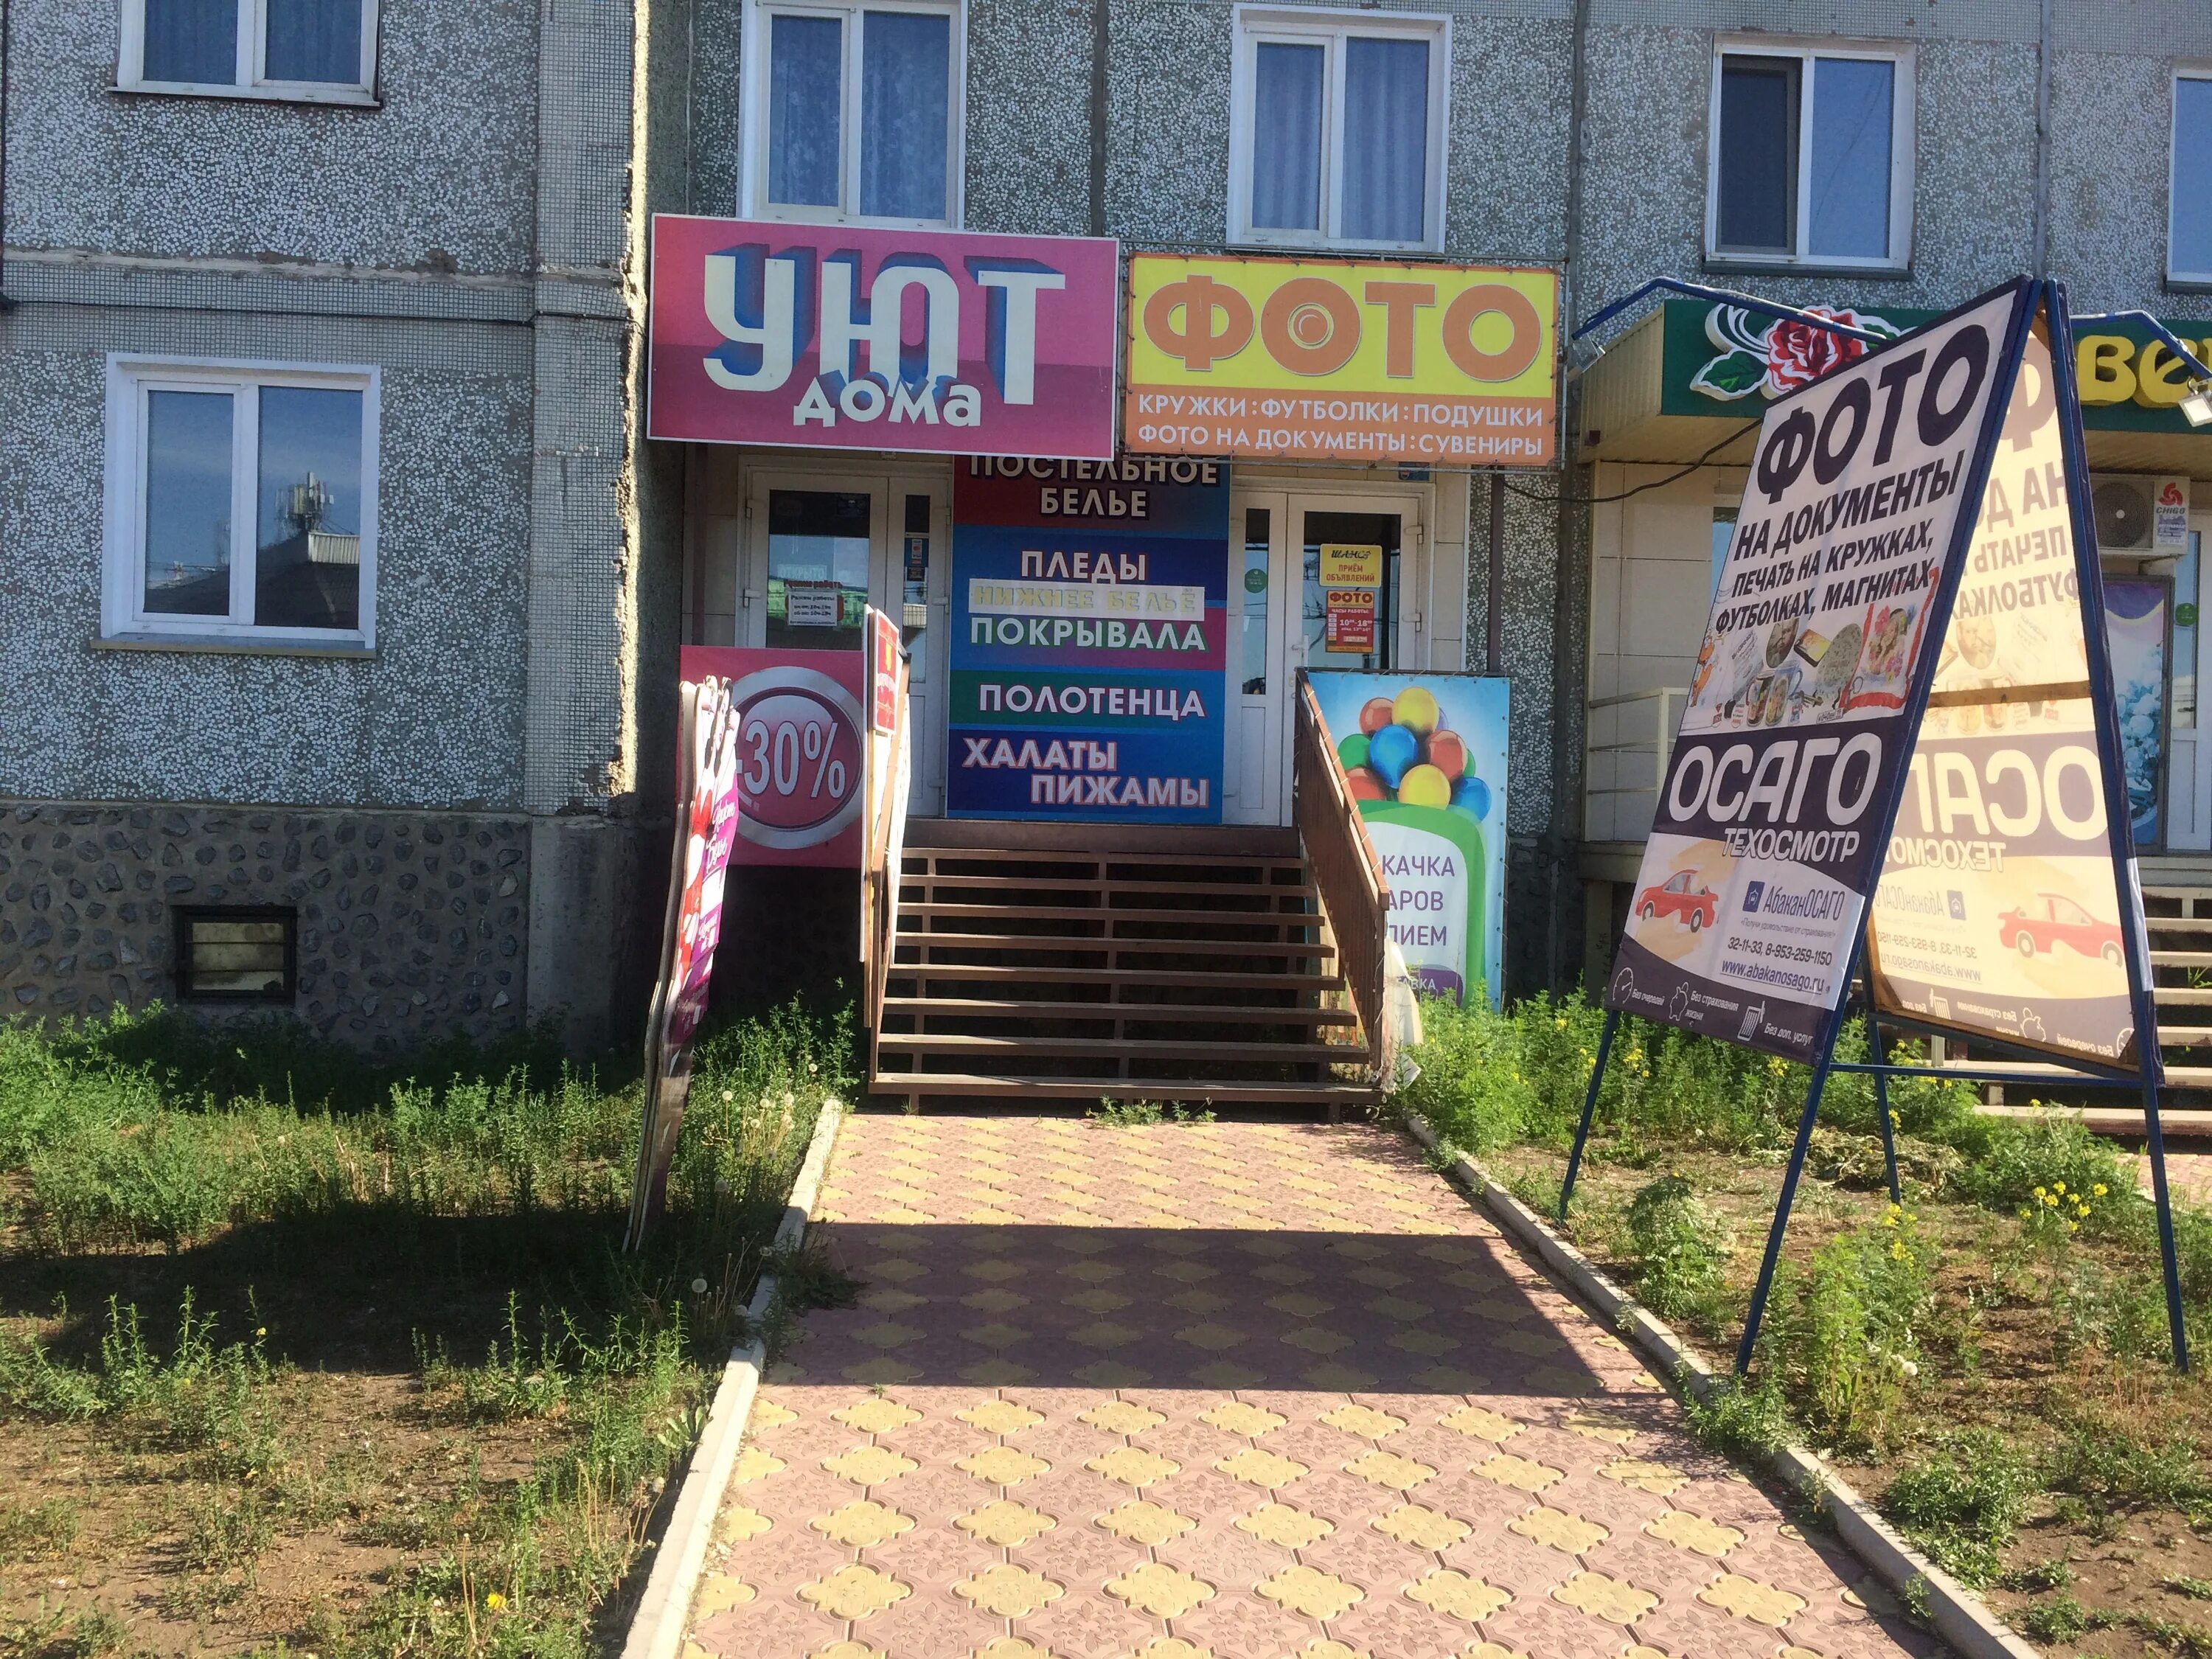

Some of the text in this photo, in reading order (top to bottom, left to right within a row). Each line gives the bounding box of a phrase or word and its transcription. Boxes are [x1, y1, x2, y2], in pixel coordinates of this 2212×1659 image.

[703, 243, 1066, 405] УЮТ
[1142, 274, 1543, 383] ФОТО
[1413, 403, 1543, 428] ПОДУШКИ
[1757, 324, 1990, 504] ФОТО
[1138, 424, 1209, 445] ФОТО
[1216, 428, 1251, 447] НА
[1419, 434, 1543, 456] СУВЕНИРЫ
[970, 455, 1217, 484] ПОСТЕЛЬНОЕ
[1040, 487, 1147, 518] БЕЛЬЕ
[1733, 518, 1771, 561] НА
[1770, 450, 1965, 558] ДОКУМЕНТЫ
[2155, 507, 2186, 515] CHIGO
[1020, 550, 1147, 585] ПЛЕДЫ
[1338, 563, 1363, 572] ПРИЁМ
[1731, 518, 1933, 598] ПЕЧАТЬ НА КРУЖКАХ,
[1326, 573, 1376, 582] ОБЪЯВЛЕНИЙ
[974, 585, 1095, 609] НИЖНЕЕ
[1329, 592, 1373, 604] ФОТО
[1715, 557, 1935, 635] ФУТБОЛКАХ, МАГНИТАХ
[970, 617, 1207, 651] ПОКРЫВАЛА
[979, 684, 1206, 721] ПОЛОТЕНЦА
[961, 737, 1117, 771] ХАЛАТЫ
[1031, 775, 1209, 807] ПИЖАМЫ
[1668, 732, 1882, 825] ОСАГО
[1722, 828, 1860, 863] ТЕХОСМОТР
[1382, 855, 1455, 877] КАЧКА
[1388, 889, 1444, 911] АРОВ
[1763, 886, 1846, 921] АбаканОСАГО
[1765, 942, 1832, 966] 8-953-259-1150
[1722, 959, 1825, 992] www.abakanosago.ru
[1632, 988, 1665, 1006] Без очередей
[1691, 990, 1739, 1012] Без страхования
[1764, 1023, 1778, 1034] Без
[1792, 1032, 1814, 1045] услуг
